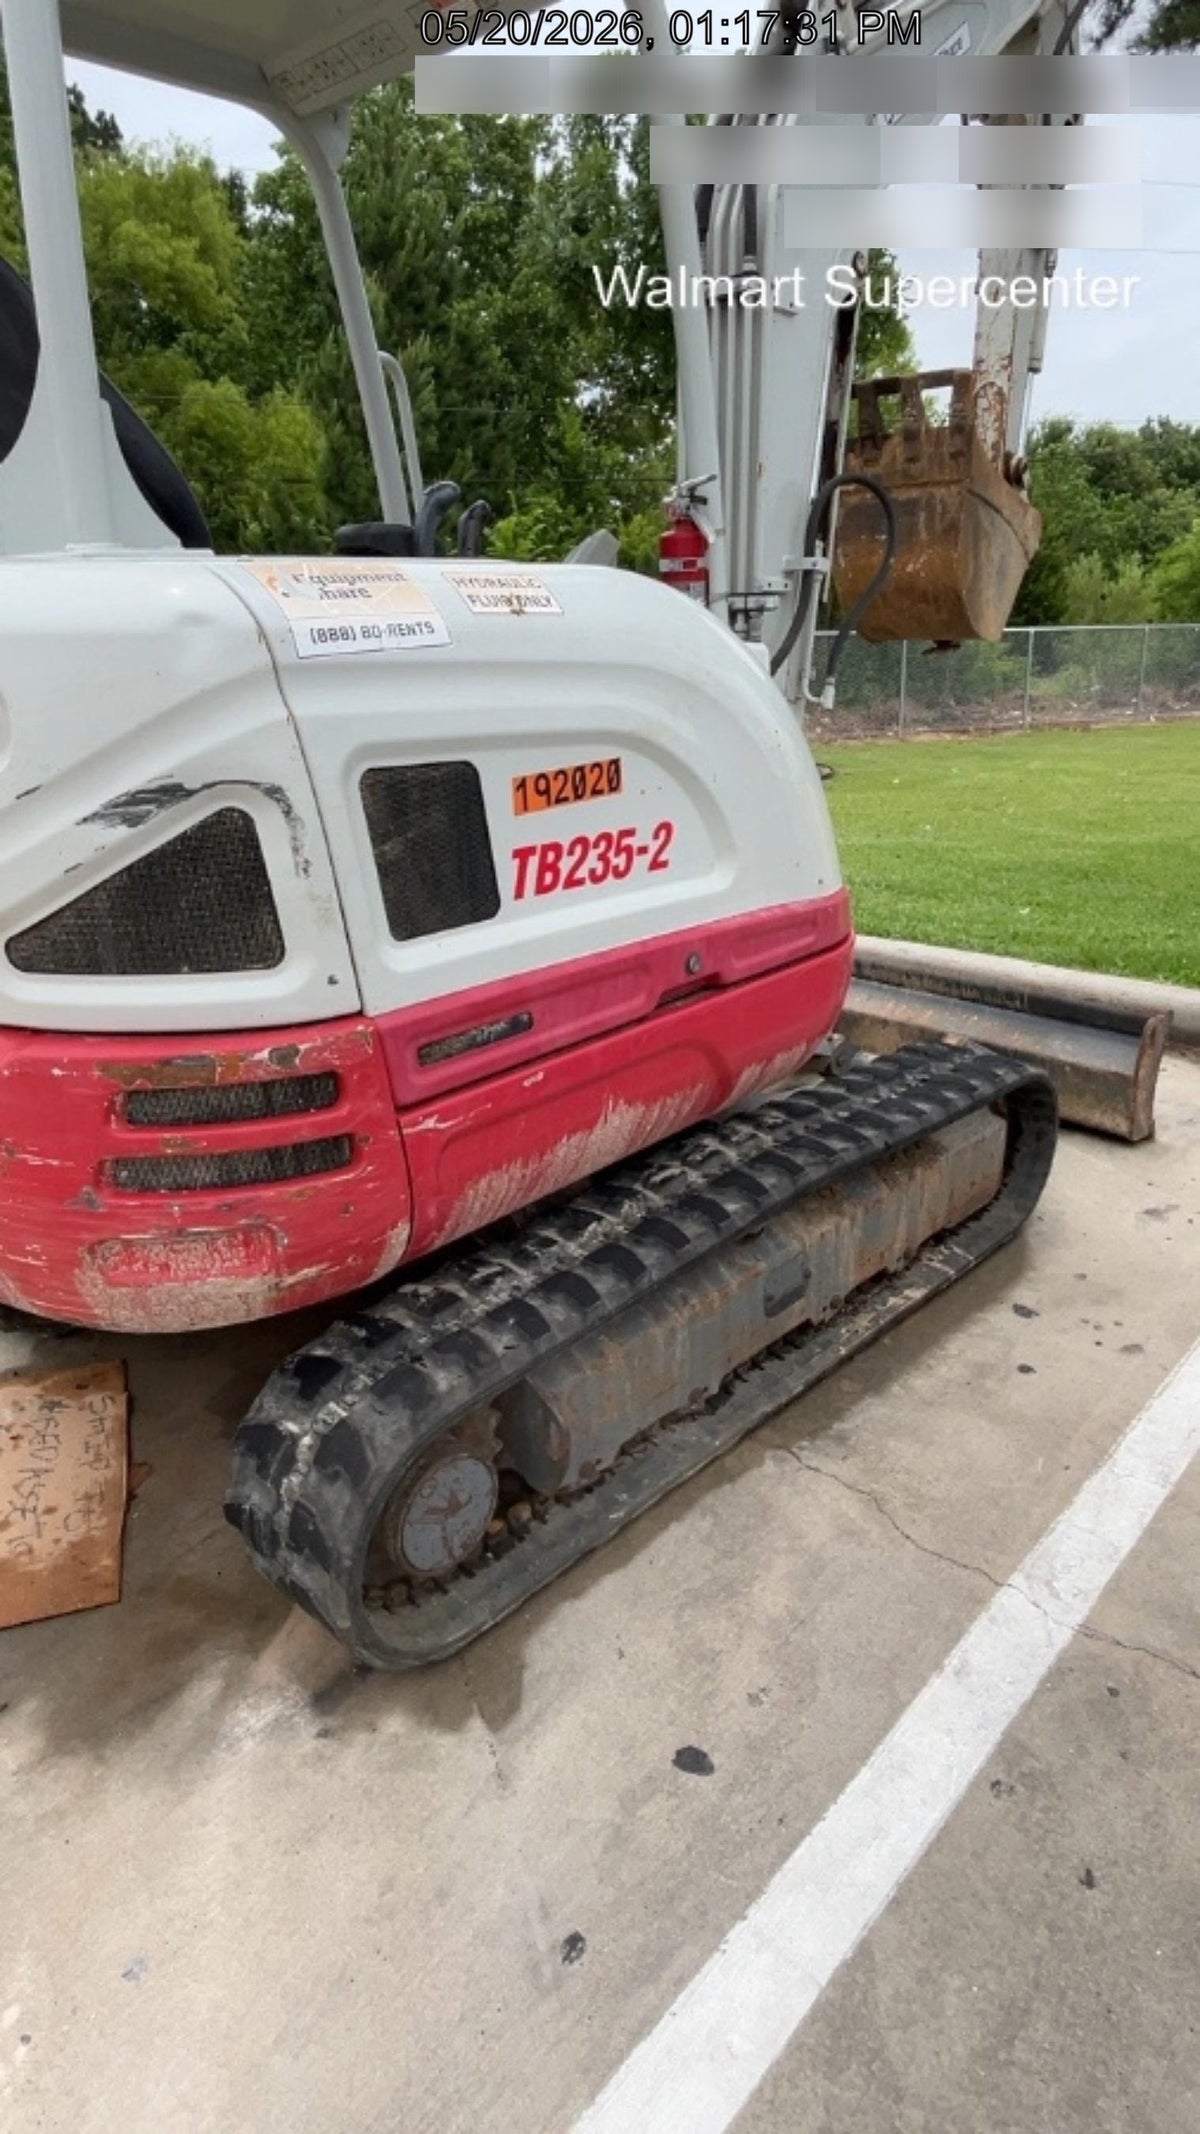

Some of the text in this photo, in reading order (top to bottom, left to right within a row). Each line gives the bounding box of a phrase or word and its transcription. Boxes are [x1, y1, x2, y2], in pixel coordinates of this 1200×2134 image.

[310, 627, 357, 644] (888)
[515, 758, 622, 812] 192020
[511, 821, 673, 901] TB235-2
